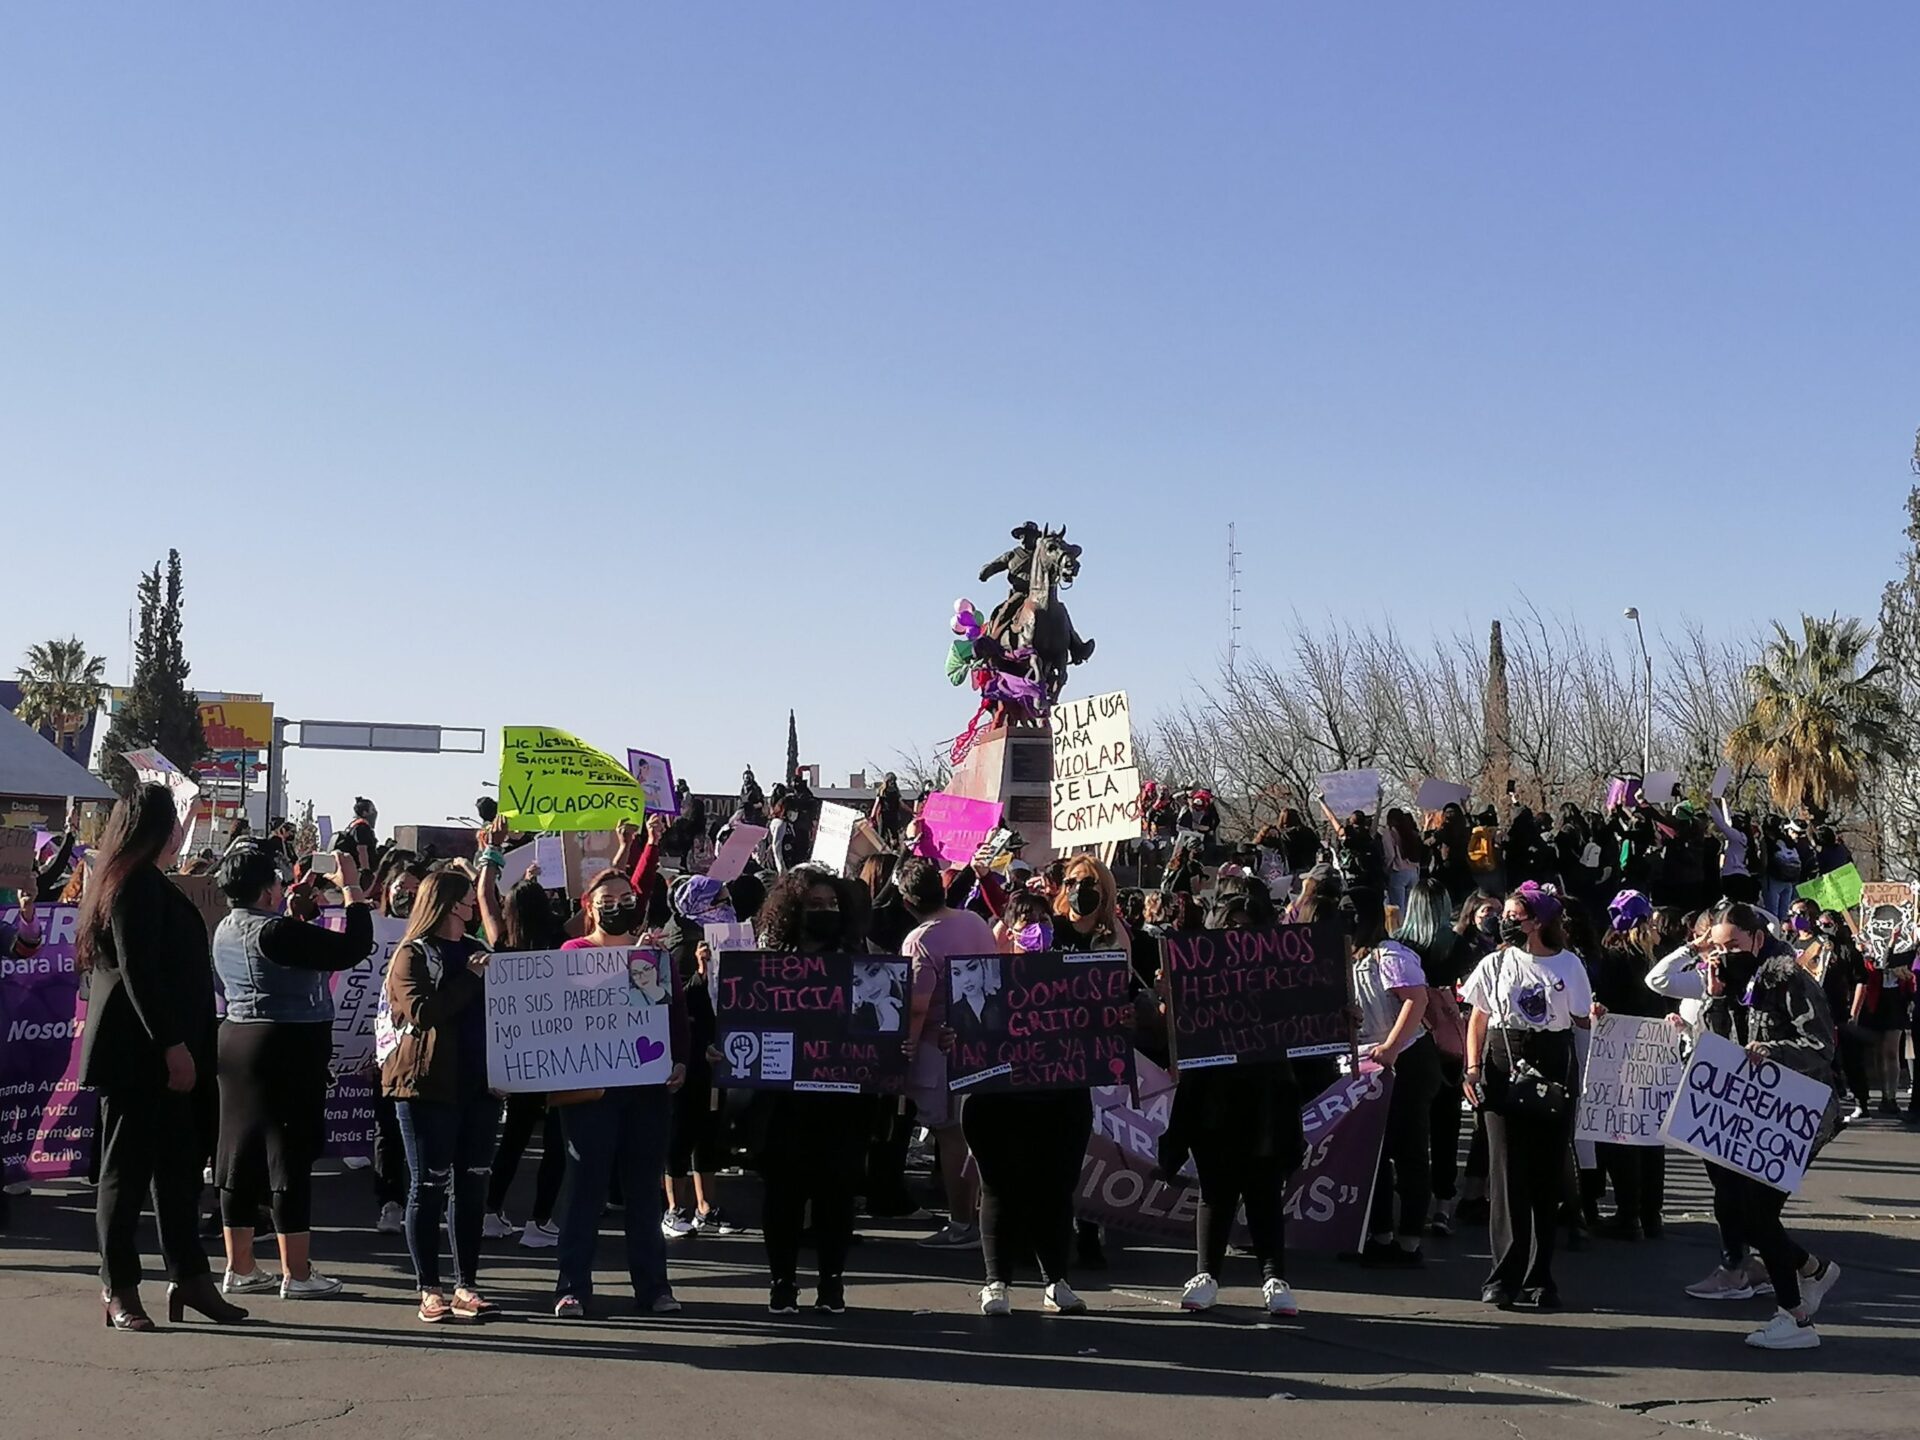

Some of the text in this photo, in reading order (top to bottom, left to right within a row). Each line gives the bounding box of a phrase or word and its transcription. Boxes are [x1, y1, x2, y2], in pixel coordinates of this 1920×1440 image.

[1054, 693, 1126, 735] SI LA USA
[1054, 730, 1092, 754] PARA
[1054, 742, 1126, 778] VIOLAR
[508, 784, 639, 814] VIOLADORES
[1053, 774, 1119, 807] SE LA
[1168, 926, 1316, 971] NO SOMOS
[0, 953, 75, 978] para la
[488, 950, 629, 985] USTEDES LLORAN
[753, 954, 828, 982] #8M
[721, 976, 846, 1012] JUSTICIA
[1008, 958, 1103, 1008] SOMOS
[489, 996, 517, 1017] POR
[525, 993, 554, 1014] SUS
[1177, 992, 1262, 1034] SOMOS
[532, 1016, 573, 1036] LLORO
[586, 1013, 617, 1031] POR
[627, 1010, 650, 1027] MI
[1008, 1008, 1090, 1037] GRITO
[1636, 1020, 1672, 1043] ESTAN
[504, 1038, 638, 1083] HERMANA!
[803, 1039, 832, 1061] NI
[998, 1040, 1046, 1063] QUE
[1060, 1039, 1087, 1063] YA
[1096, 1034, 1127, 1060] NO
[1622, 1042, 1678, 1065] NUESTRAS
[1010, 1060, 1087, 1086] ESTAN
[1625, 1062, 1679, 1086] PORQUE
[1736, 1057, 1781, 1089] NO
[1581, 1082, 1612, 1106] ESDE
[1618, 1085, 1634, 1108] LA
[1689, 1061, 1823, 1141] QUEREMOS
[31, 1104, 78, 1118] Arvizu
[1582, 1107, 1650, 1136] SE PUEDE
[328, 1130, 362, 1142] Jesús
[1690, 1094, 1807, 1167] VIVIR CON
[31, 1148, 82, 1163] Carrillo
[1687, 1126, 1785, 1184] MIEDO
